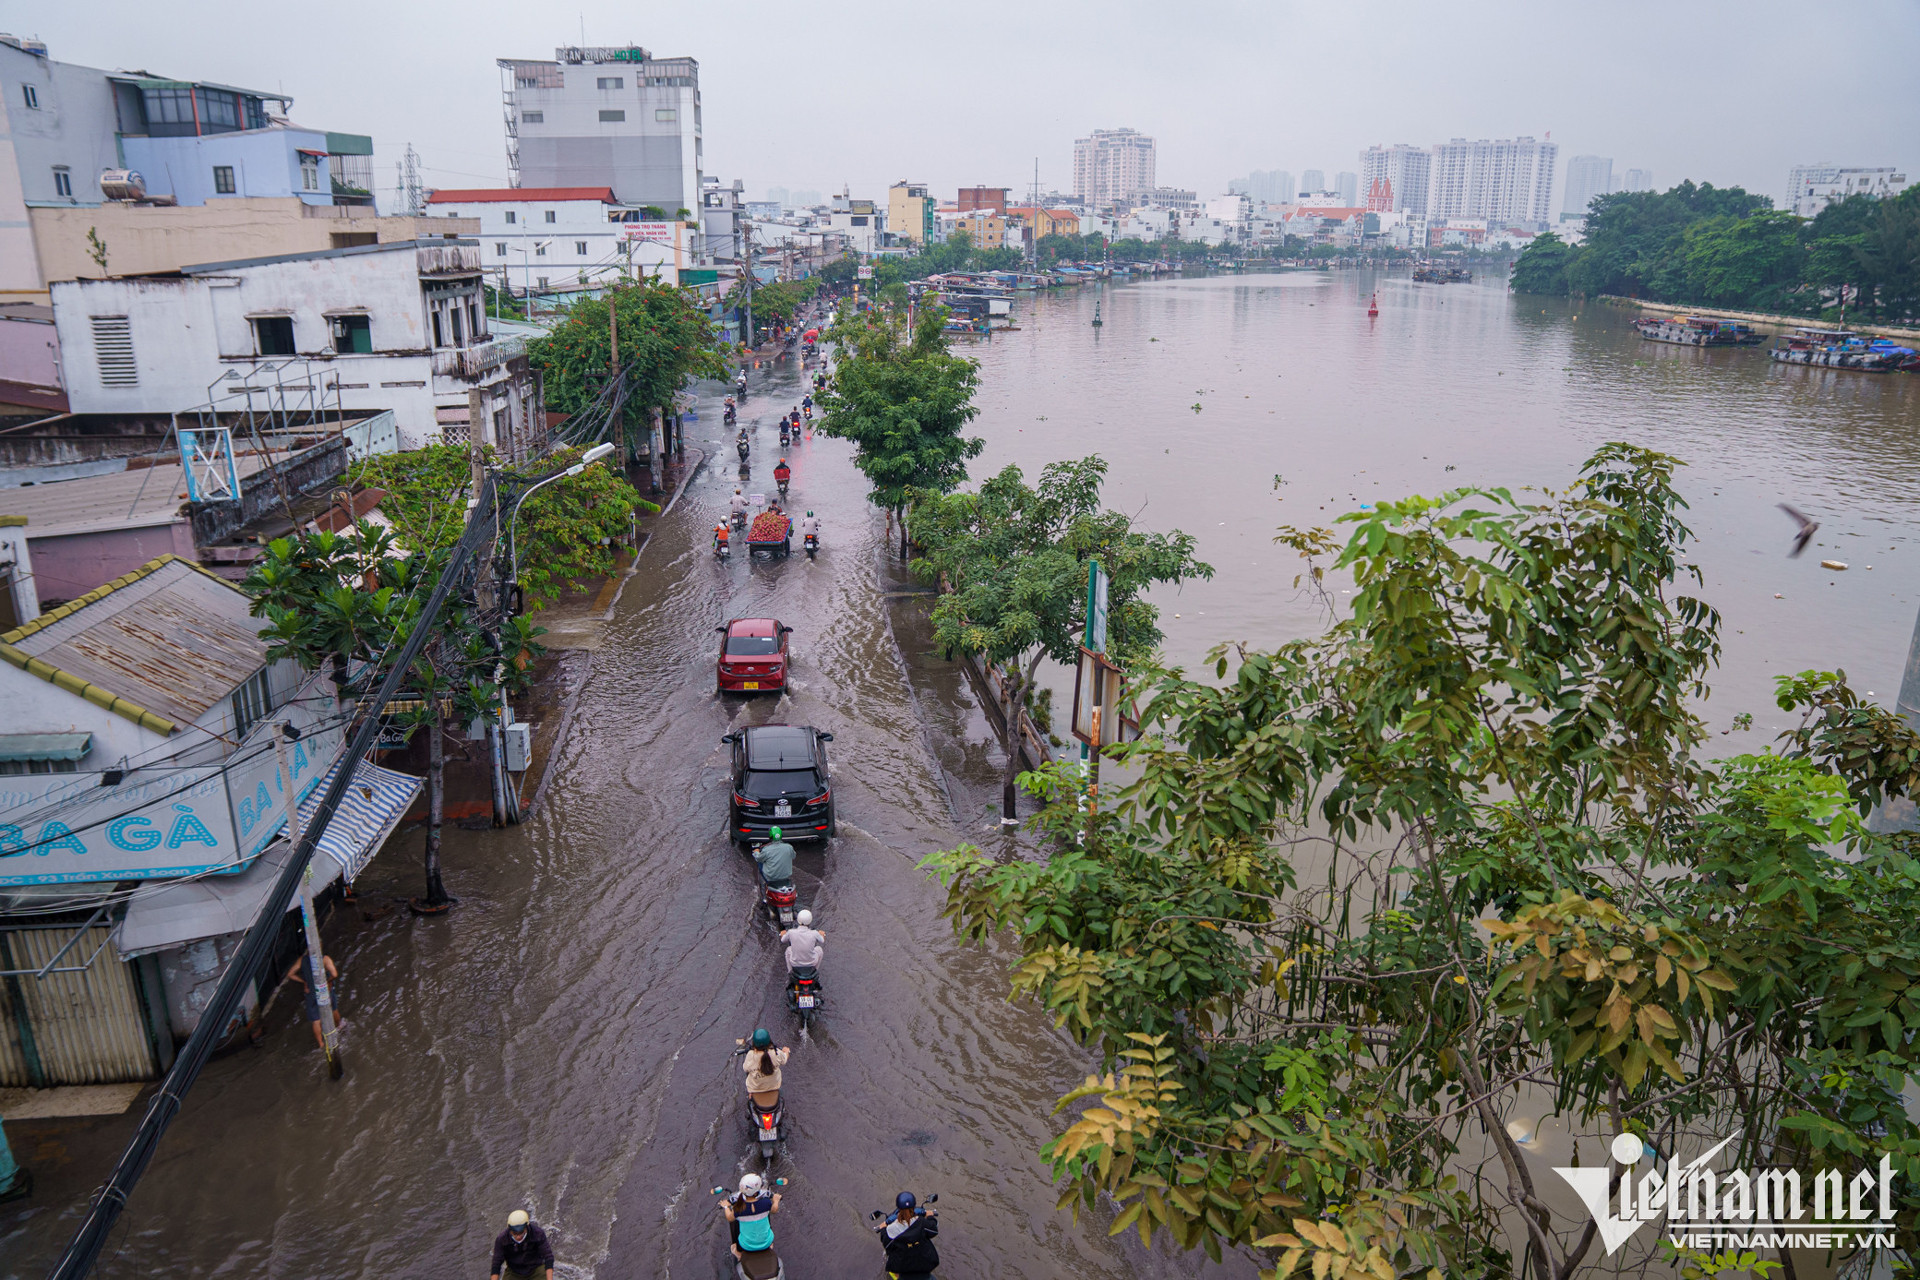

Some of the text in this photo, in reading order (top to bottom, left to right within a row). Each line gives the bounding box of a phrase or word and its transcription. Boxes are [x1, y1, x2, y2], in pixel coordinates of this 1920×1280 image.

[614, 49, 643, 61] HOTEL
[238, 780, 273, 838] BA
[0, 820, 88, 858] BA
[104, 802, 219, 853] GÀ
[37, 872, 58, 883] 93
[101, 866, 145, 880] Xuân
[149, 864, 191, 878] Soạn
